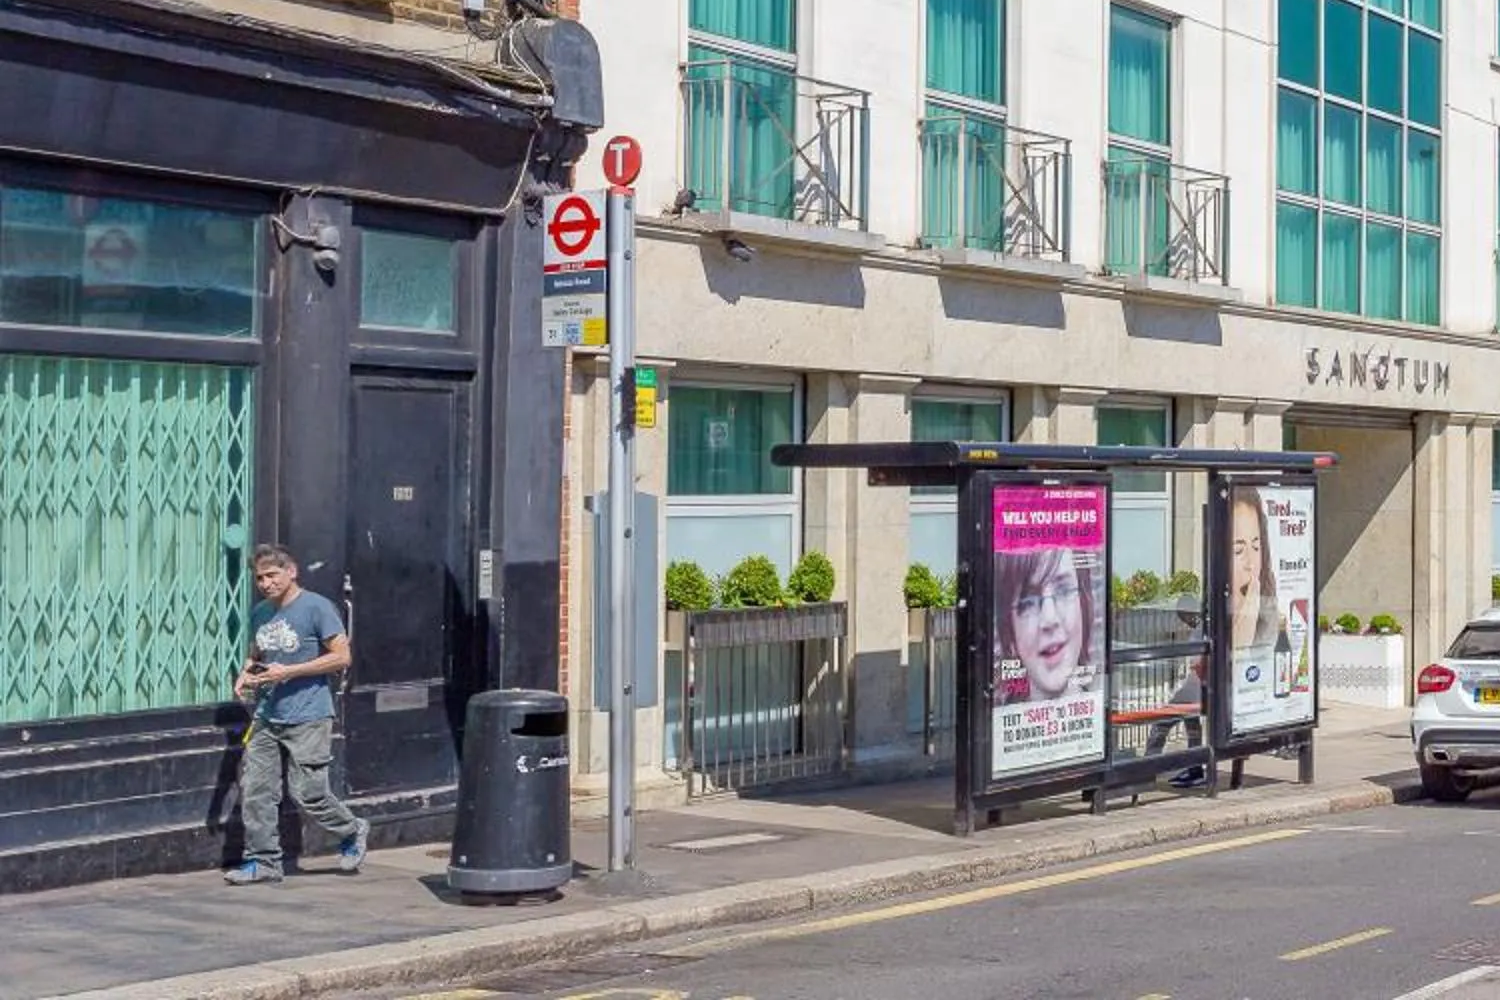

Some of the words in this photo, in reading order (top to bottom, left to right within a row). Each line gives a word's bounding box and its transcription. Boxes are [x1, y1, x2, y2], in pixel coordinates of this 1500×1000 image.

[610, 143, 630, 177] T
[1002, 511, 1028, 524] WILL
[1030, 511, 1052, 524] YOU
[1053, 510, 1080, 523] HELP
[1081, 509, 1097, 523] US
